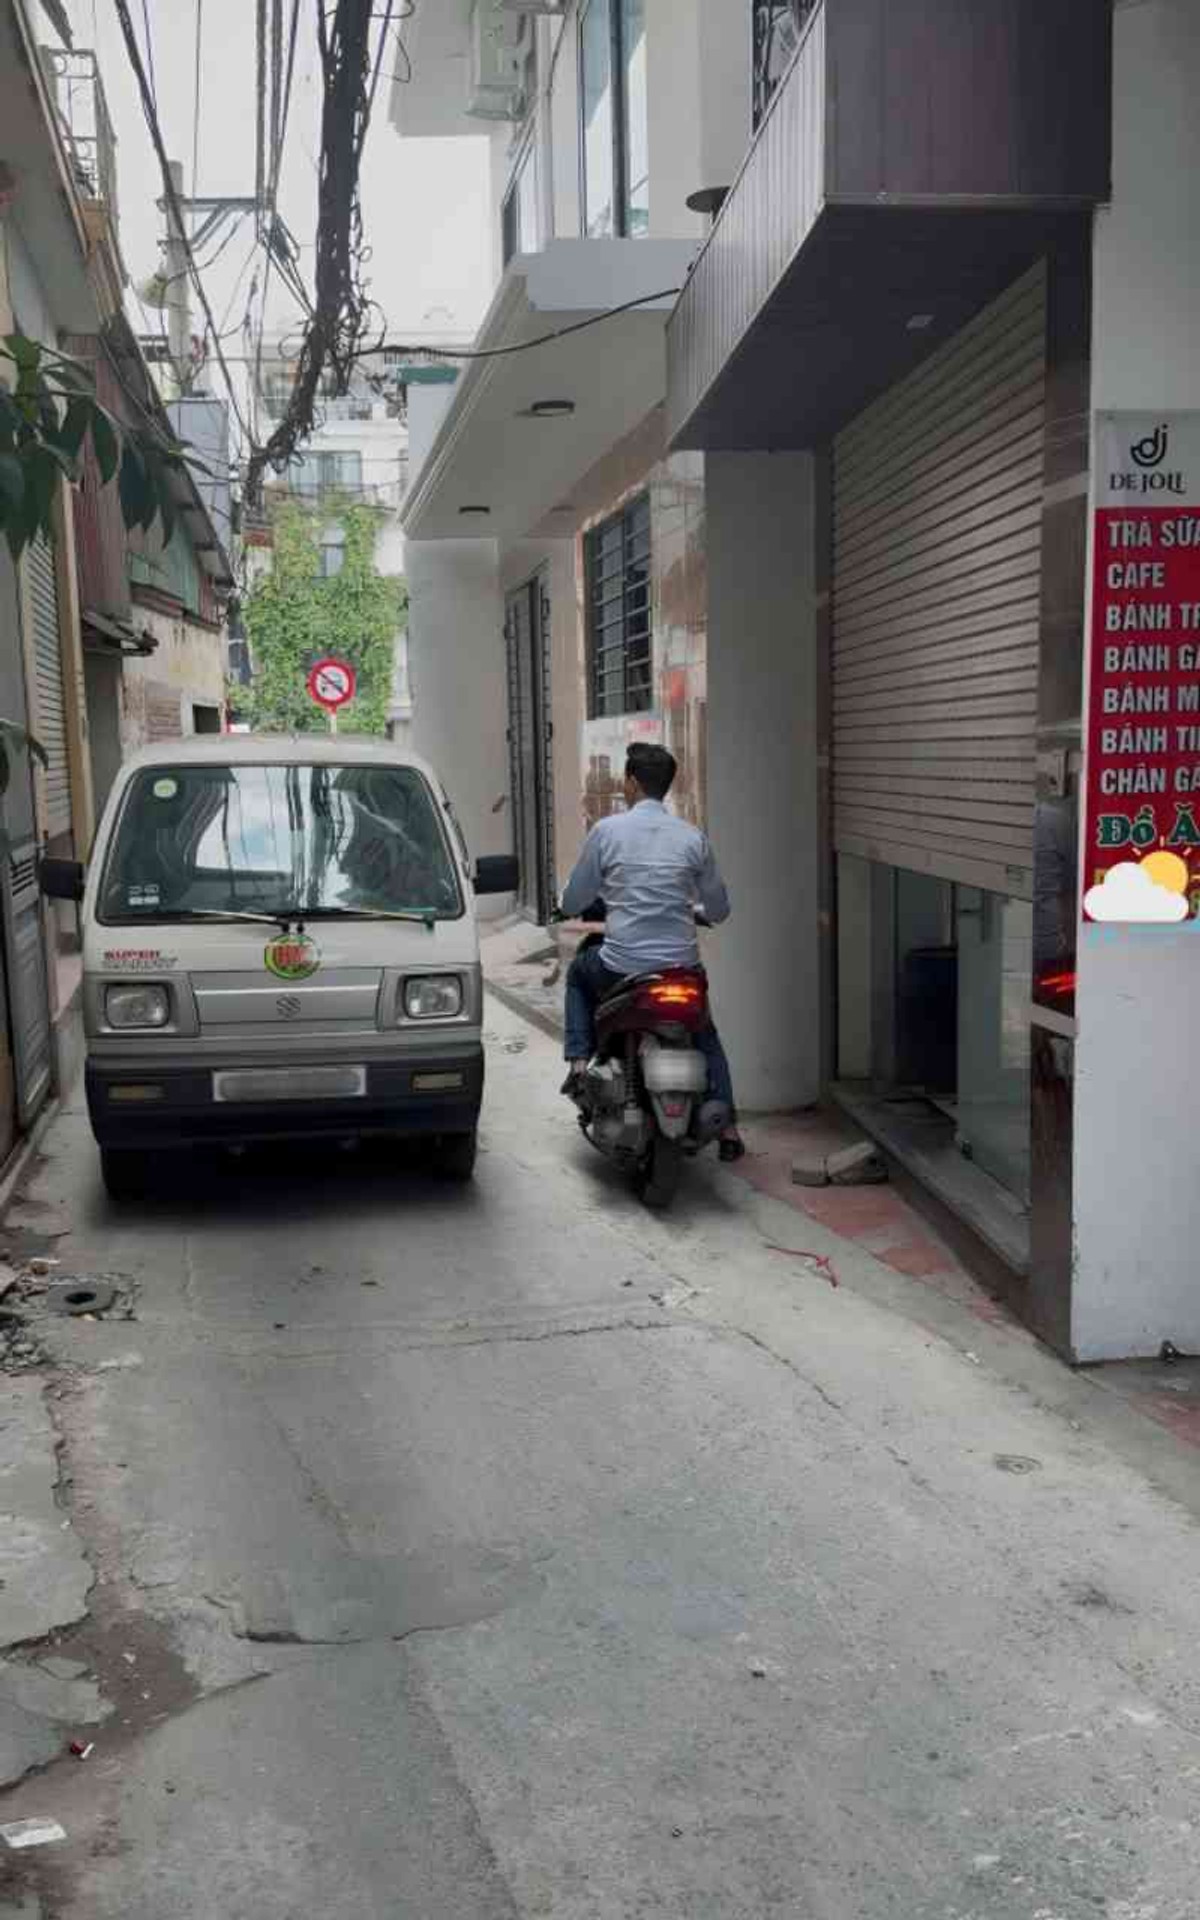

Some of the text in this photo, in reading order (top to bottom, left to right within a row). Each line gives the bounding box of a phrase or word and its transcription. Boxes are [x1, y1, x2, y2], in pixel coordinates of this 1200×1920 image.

[1110, 473, 1137, 491] DE
[1107, 562, 1165, 589] CAFE
[1105, 597, 1171, 632] BÁNH
[1104, 640, 1170, 673] BÁNH
[1103, 681, 1169, 714] BÁNH
[1102, 722, 1200, 755] BÁNH TI
[1101, 762, 1166, 794] CHÂN
